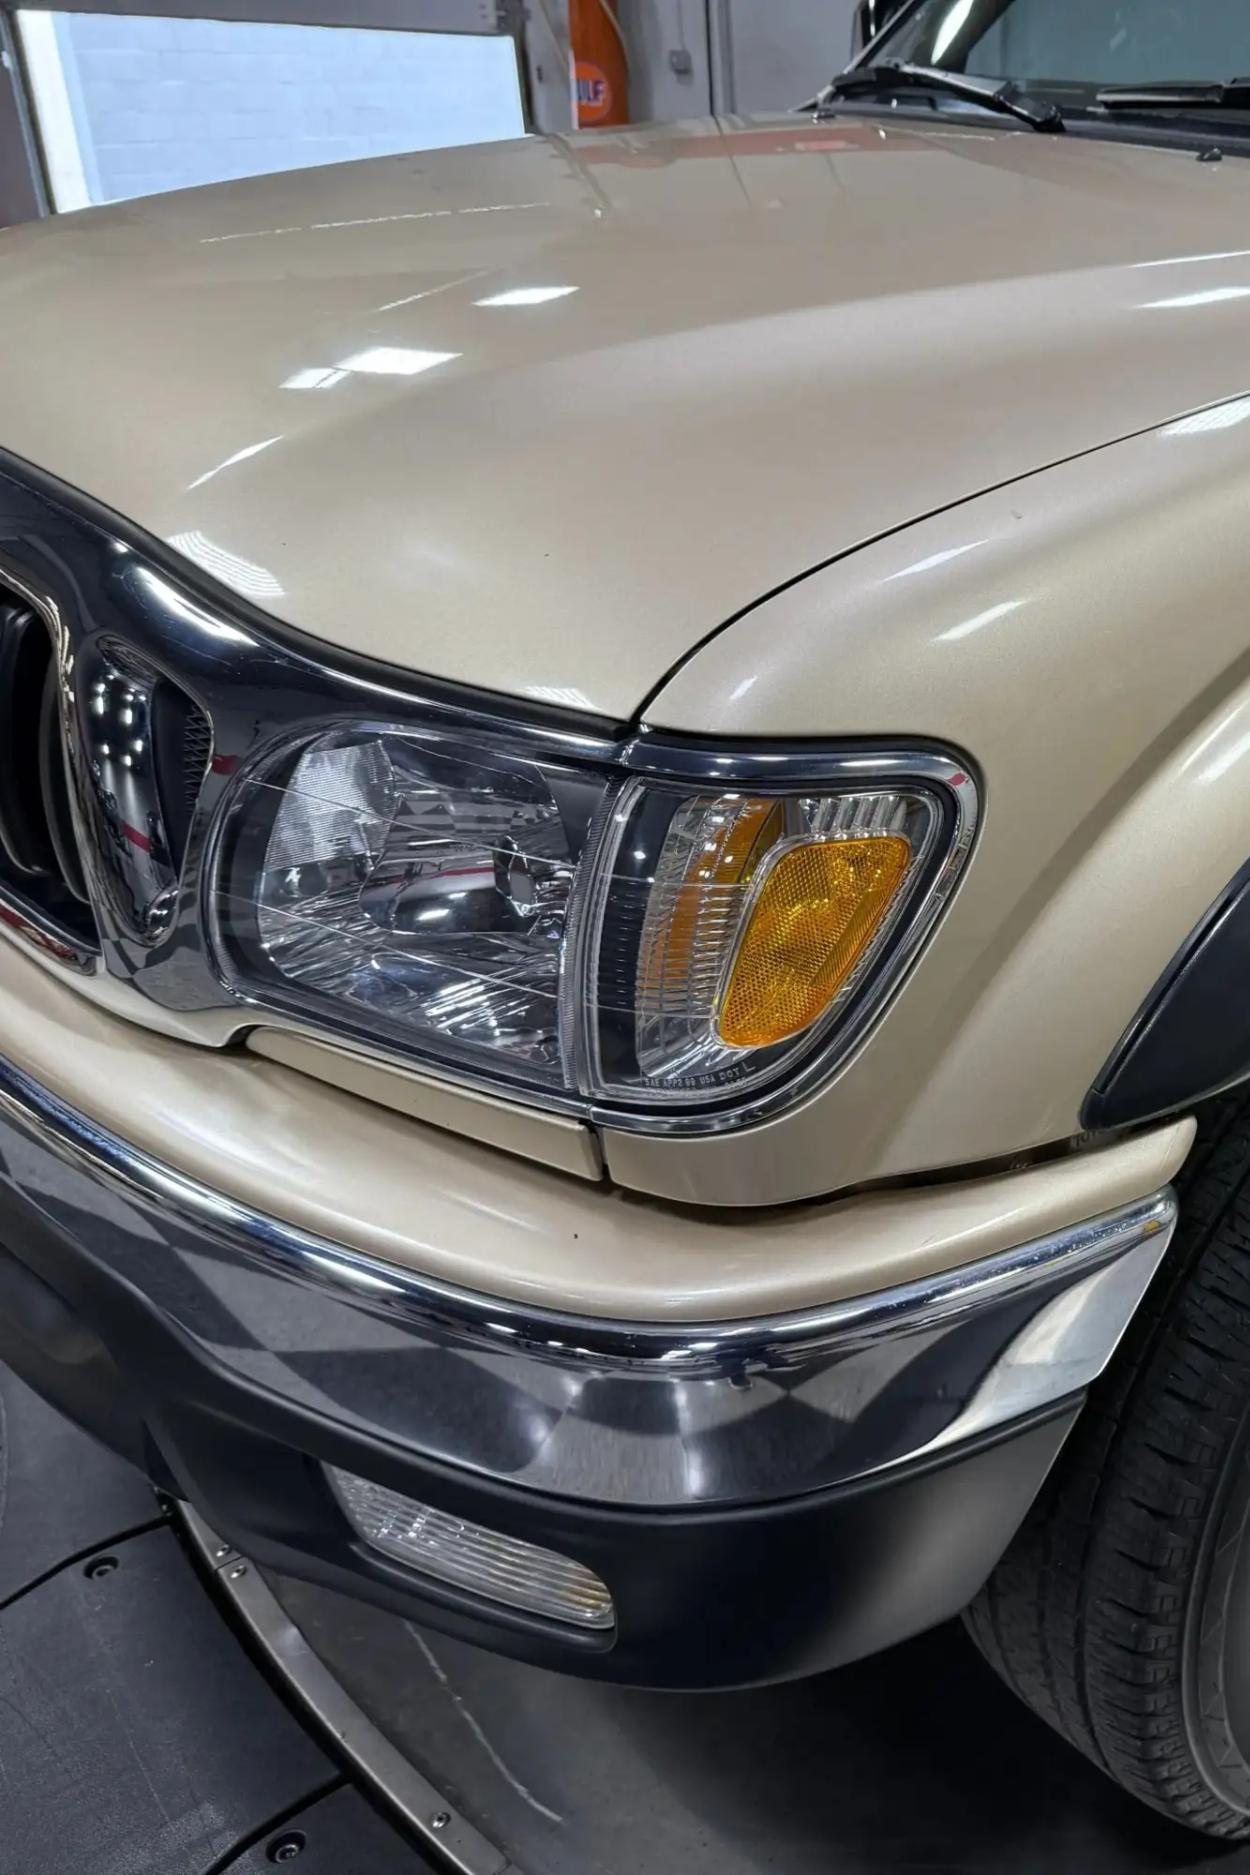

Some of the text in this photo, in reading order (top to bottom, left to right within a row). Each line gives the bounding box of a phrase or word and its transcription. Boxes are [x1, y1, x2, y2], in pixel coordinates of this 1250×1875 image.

[645, 1077, 660, 1087] SAE
[699, 1074, 717, 1085] USA
[719, 1067, 740, 1081] DOT
